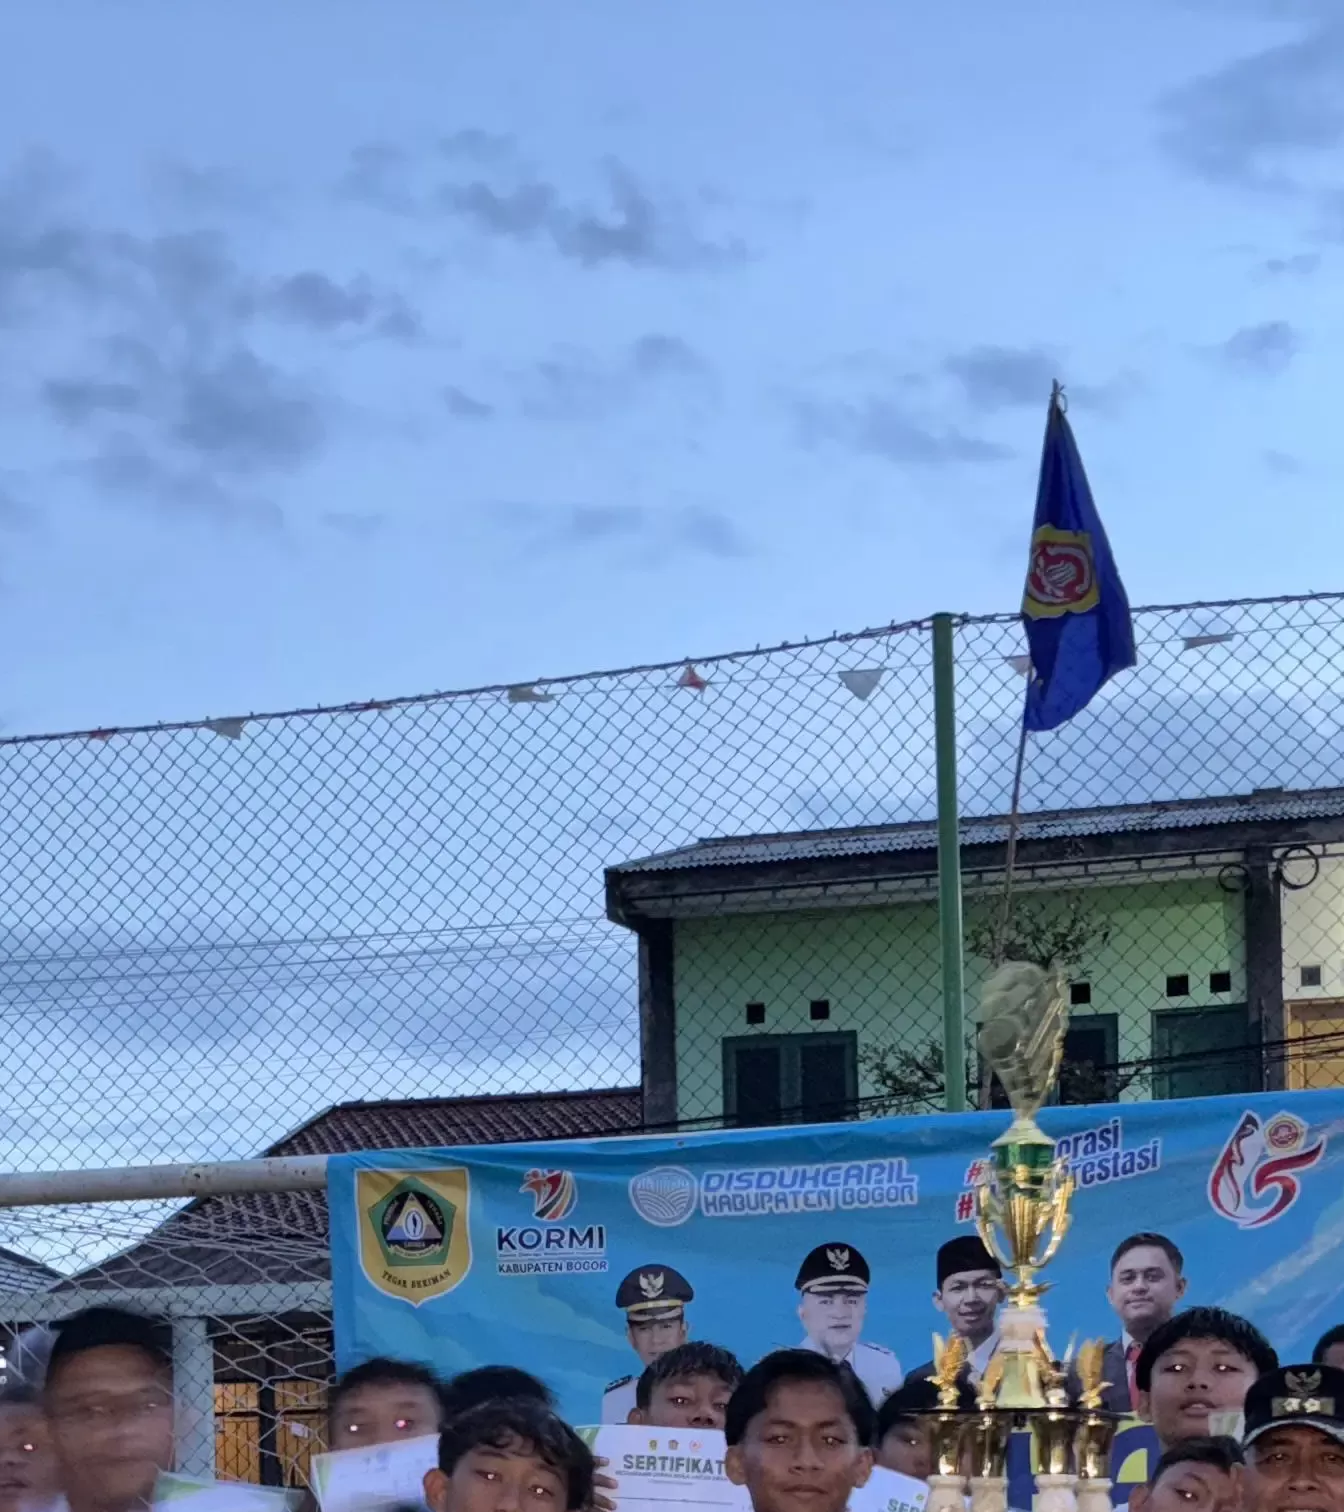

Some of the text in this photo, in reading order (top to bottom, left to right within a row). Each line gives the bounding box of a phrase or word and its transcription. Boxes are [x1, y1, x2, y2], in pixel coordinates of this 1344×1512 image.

[704, 1185, 917, 1214] KABUPATEN BOGOR
[497, 1226, 605, 1251] KORMI
[498, 1260, 608, 1275] KABUPATEN BOGOR
[623, 1453, 726, 1475] SERTIFIKAT
